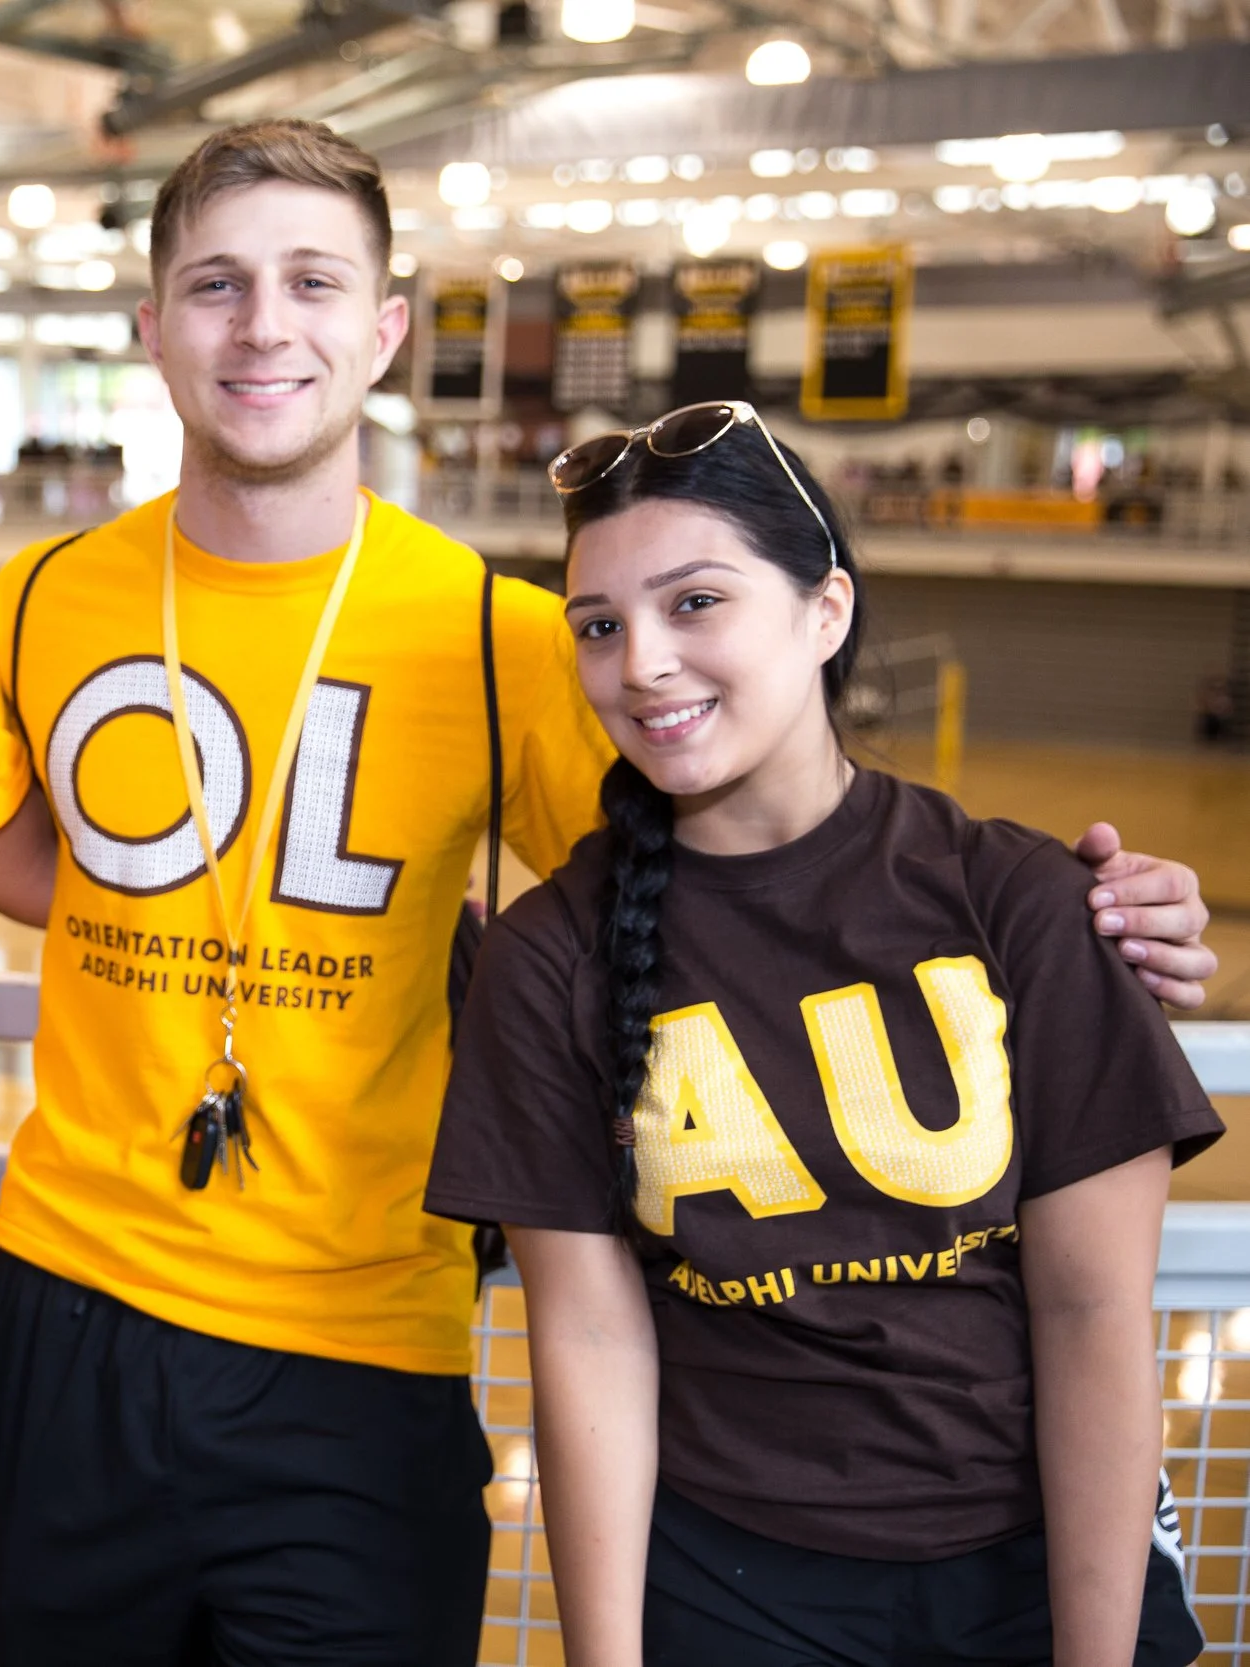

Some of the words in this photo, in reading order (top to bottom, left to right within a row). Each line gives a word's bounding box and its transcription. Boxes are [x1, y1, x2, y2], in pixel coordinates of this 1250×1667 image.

[46, 654, 406, 916] OL
[66, 914, 248, 967] ORIENTATION
[261, 947, 375, 981] LEADER
[81, 952, 168, 993] ADELPHI
[184, 973, 354, 1011] UNVERSITY
[631, 954, 1014, 1237] AU
